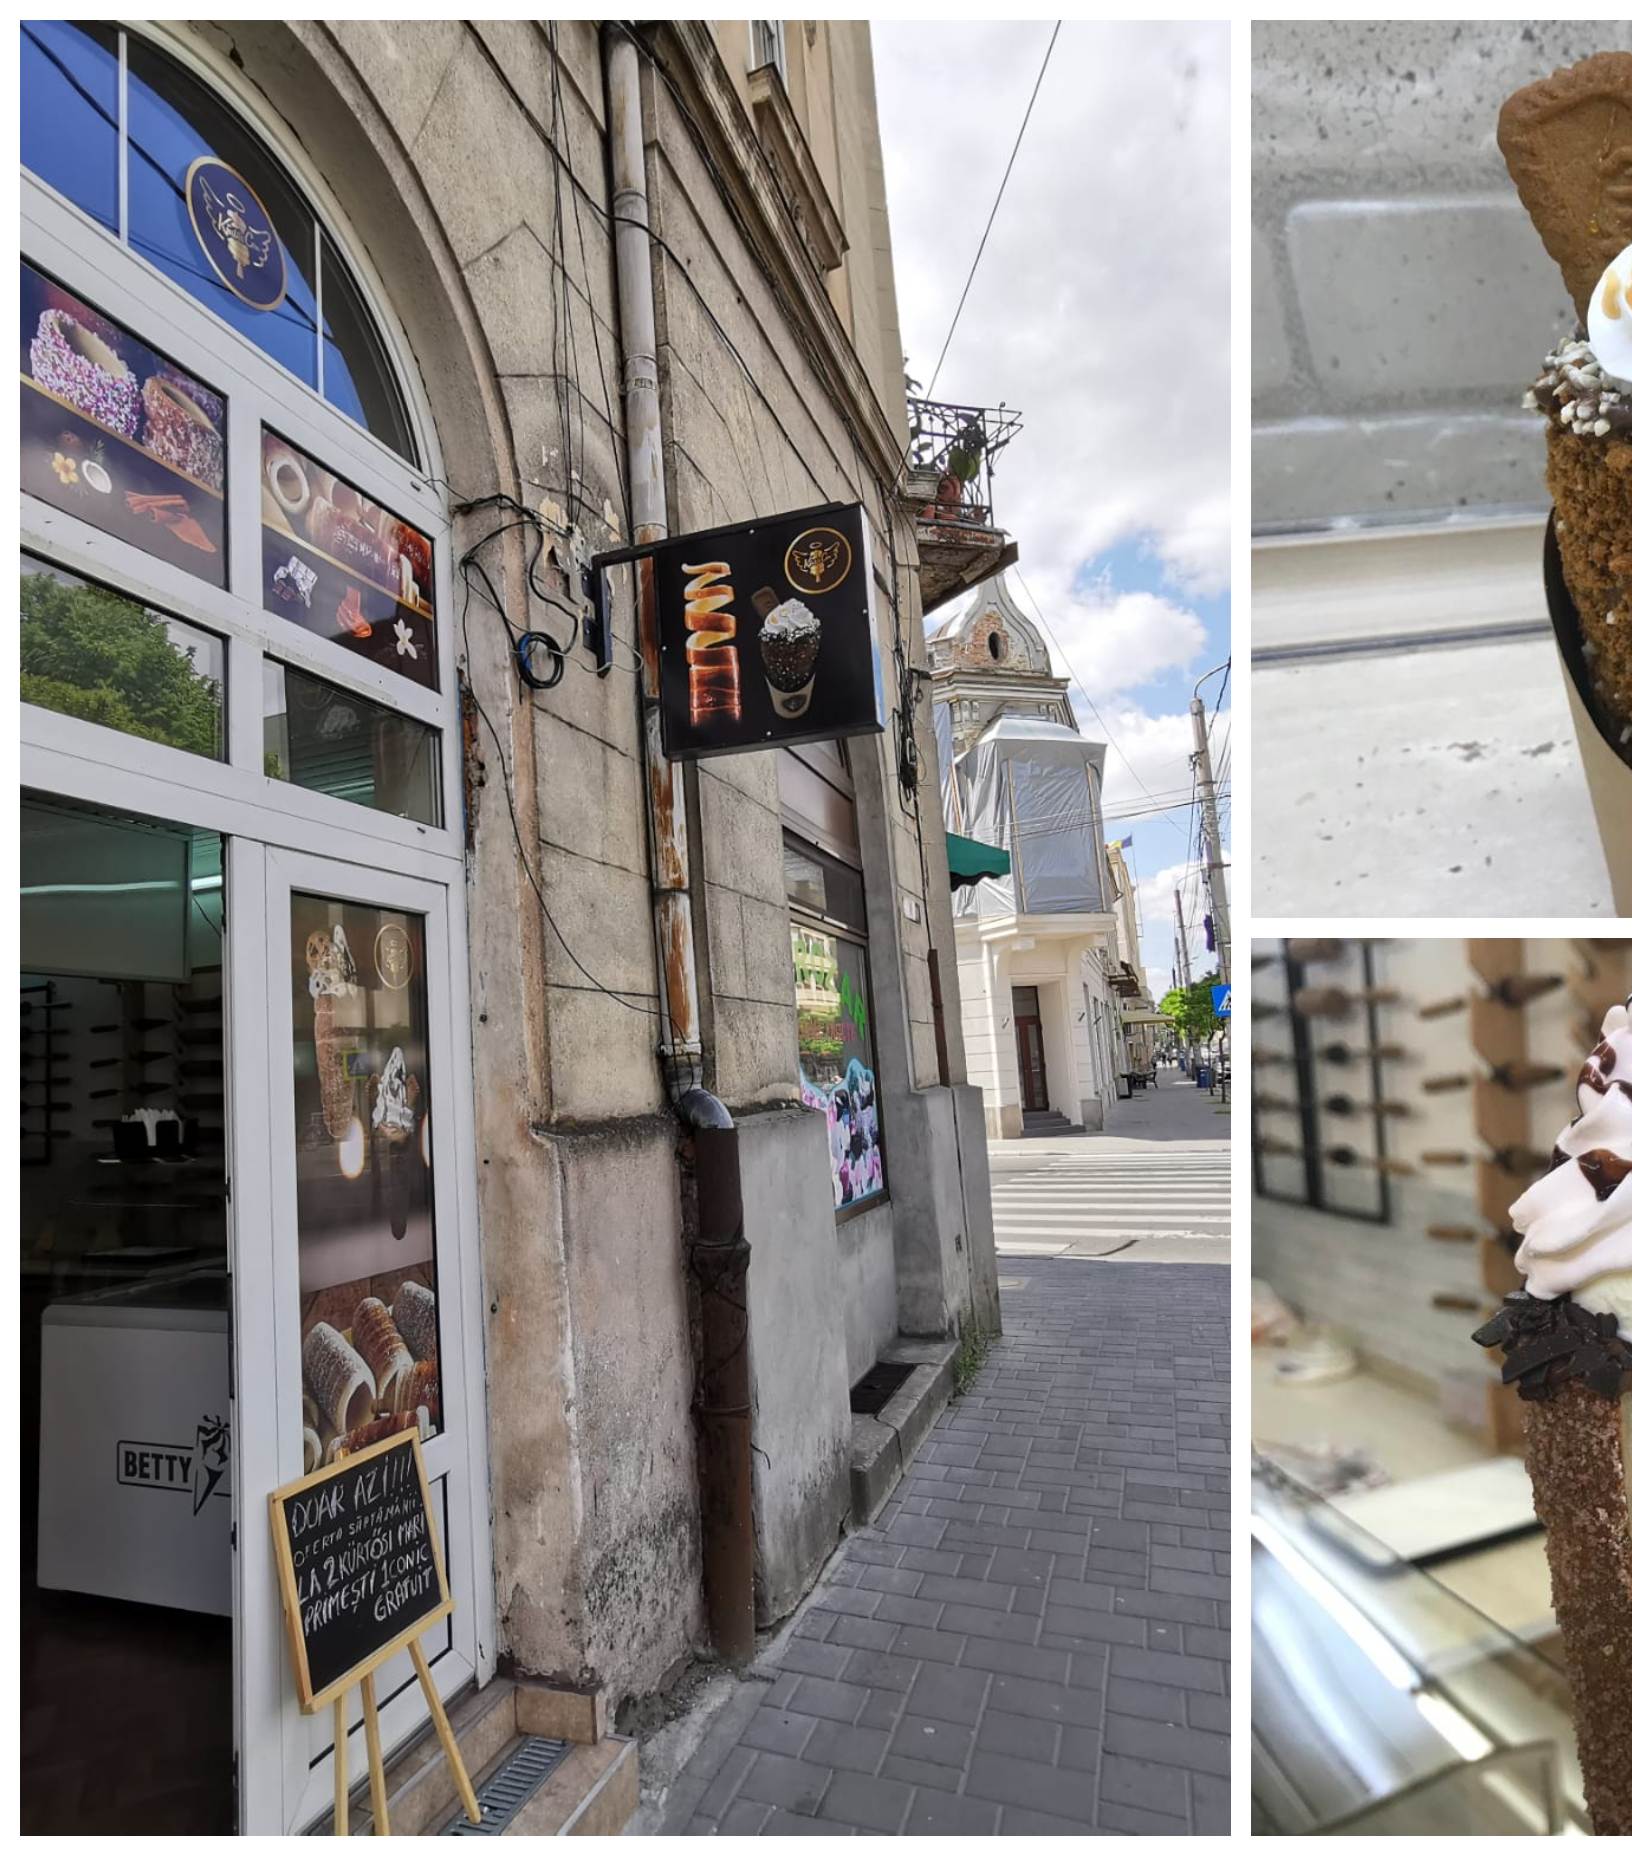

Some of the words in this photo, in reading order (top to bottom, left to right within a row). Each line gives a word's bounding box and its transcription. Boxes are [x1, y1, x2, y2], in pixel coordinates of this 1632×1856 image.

[124, 1451, 192, 1483] BETTY
[292, 1483, 345, 1538] DOAR
[294, 1527, 343, 1567] OFERTA
[299, 1568, 321, 1605] LA
[323, 1556, 339, 1590] 2
[398, 1511, 425, 1546] MARI
[381, 1560, 391, 1588] 1
[389, 1540, 429, 1578] CONIC
[374, 1565, 433, 1621] GRATUIT
